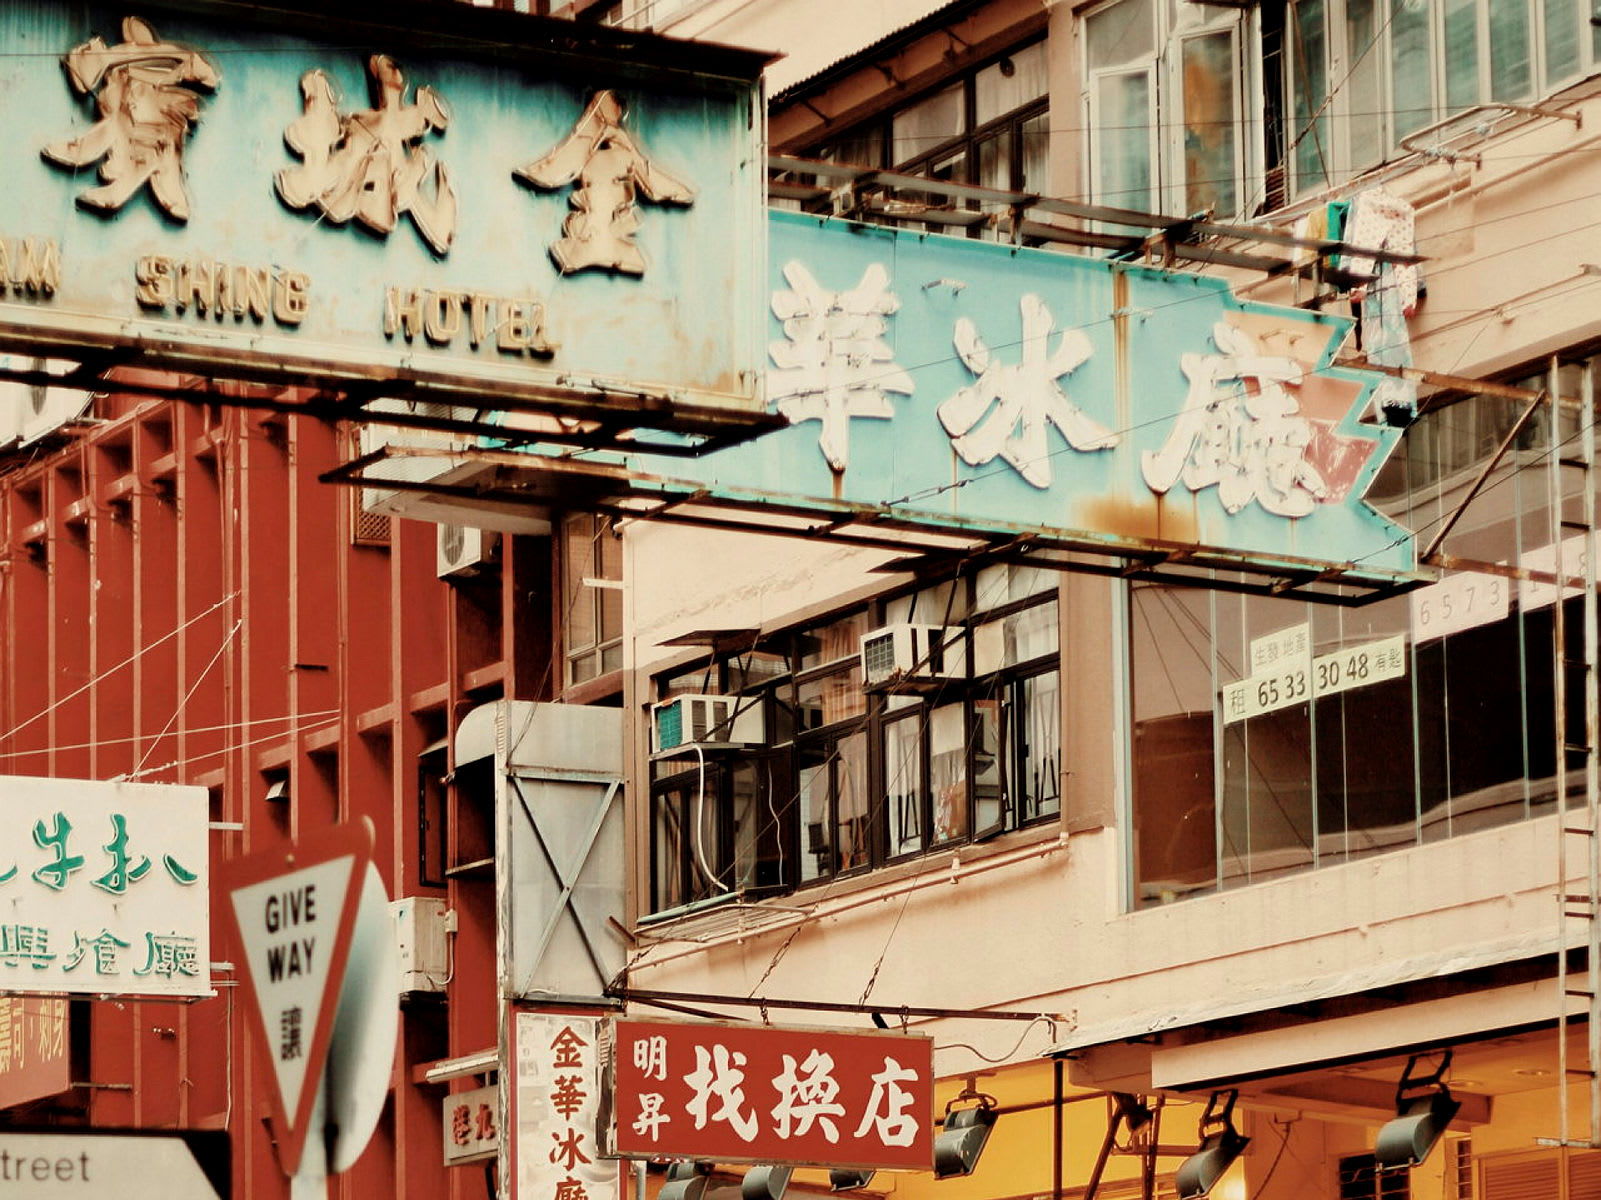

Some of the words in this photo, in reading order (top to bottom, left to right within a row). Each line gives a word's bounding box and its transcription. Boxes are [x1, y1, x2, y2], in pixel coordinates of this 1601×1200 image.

[136, 256, 311, 325] SHING
[384, 286, 561, 358] HOTEL
[1258, 678, 1279, 708] 65
[1285, 670, 1306, 699] 33
[1318, 661, 1340, 690] 30
[1346, 652, 1368, 682] 48
[264, 884, 316, 934] GIVE
[267, 936, 316, 985] WAY
[632, 1035, 671, 1143] 明昇
[683, 1043, 921, 1149] 找換店
